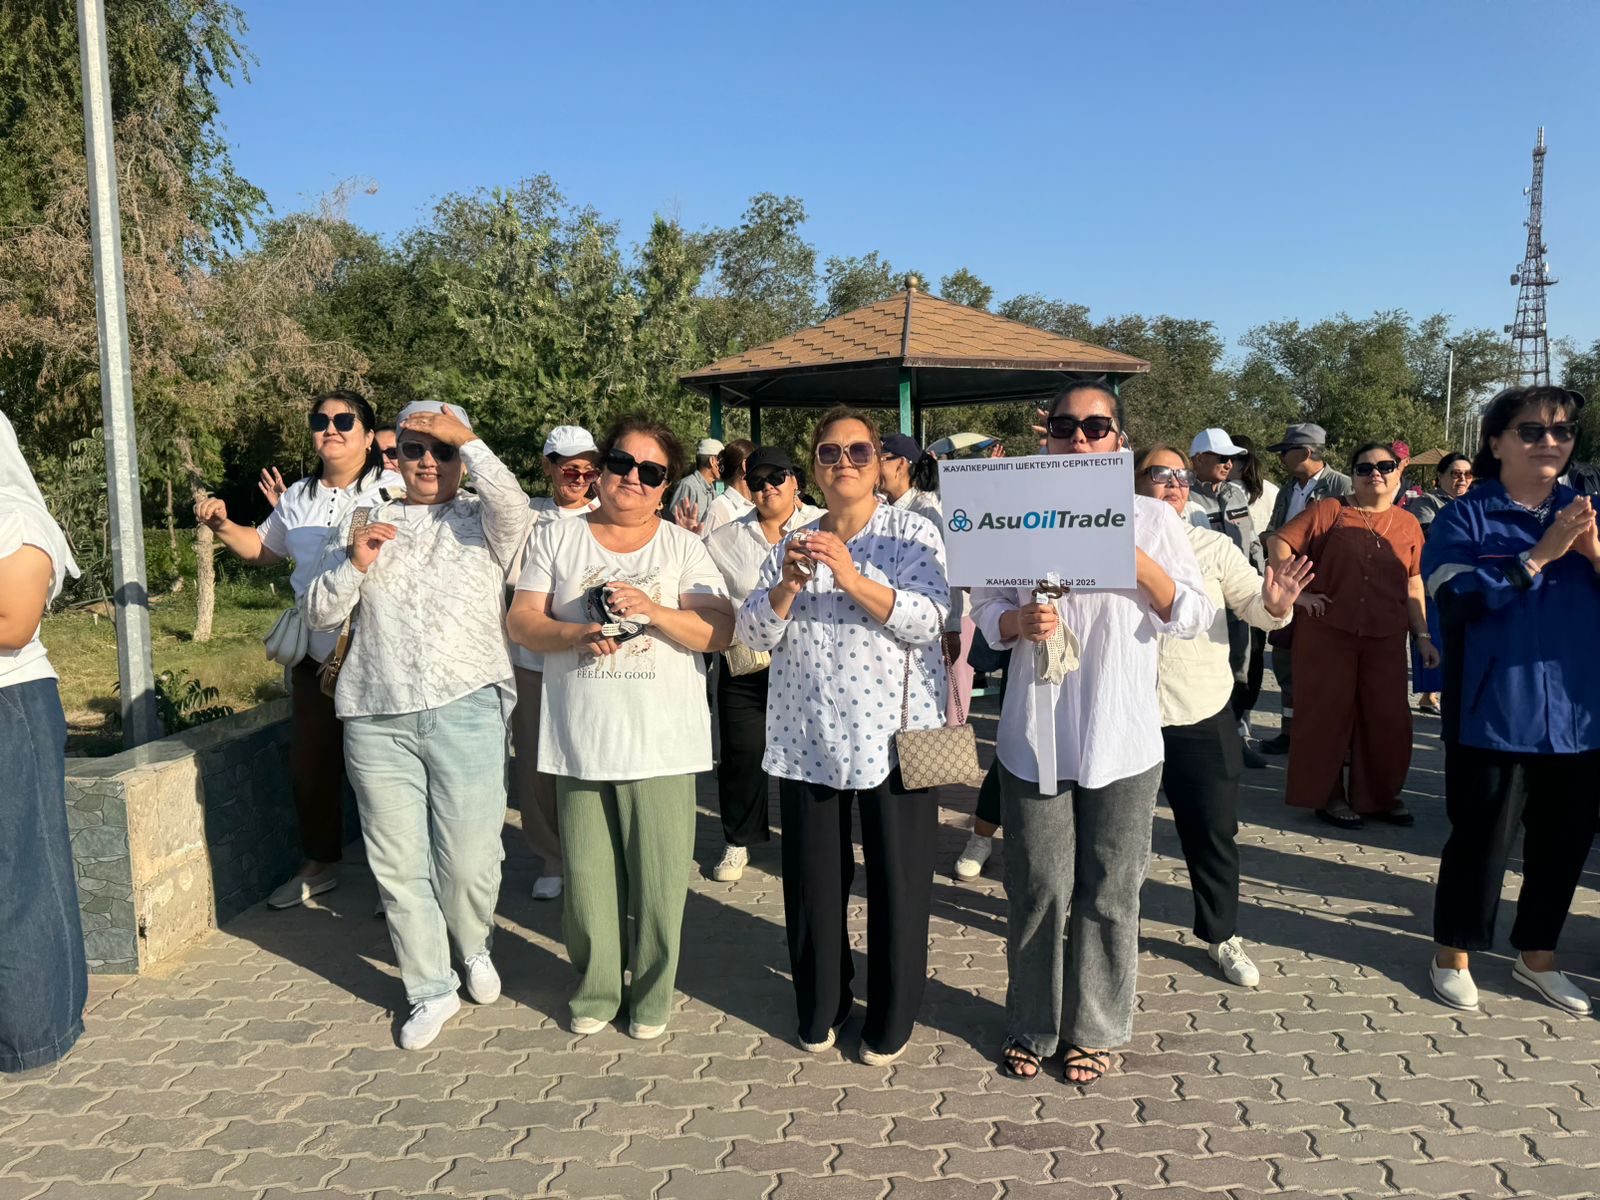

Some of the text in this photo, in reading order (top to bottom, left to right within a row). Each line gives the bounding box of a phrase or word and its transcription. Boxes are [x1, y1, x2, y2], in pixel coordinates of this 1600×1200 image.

[942, 457, 1124, 473] ЖАУАПКЕРШІЛІГІ ШЕКТЕУЛІ СЕРІКТЕСТІГІ
[977, 508, 1127, 530] AsuOilTrade
[1076, 578, 1096, 587] 2025
[577, 670, 656, 680] FEELING GOOD
